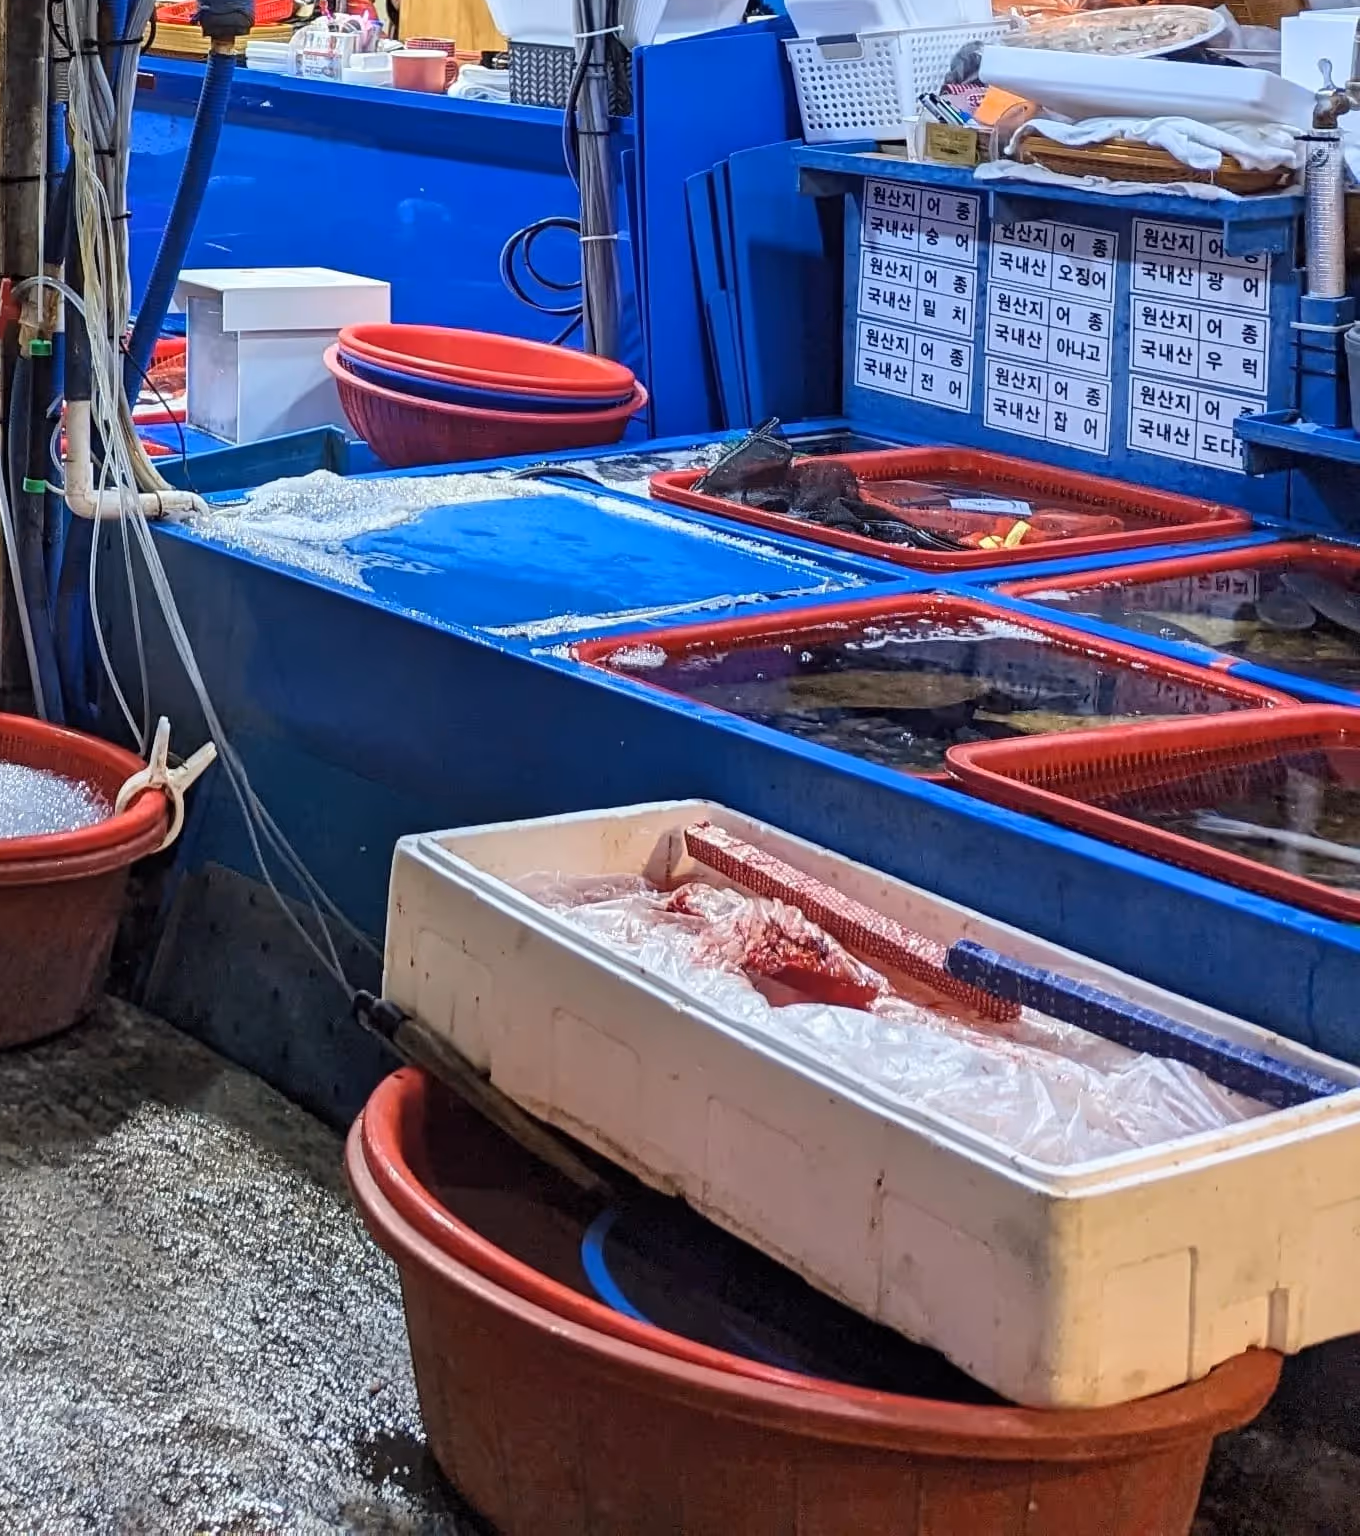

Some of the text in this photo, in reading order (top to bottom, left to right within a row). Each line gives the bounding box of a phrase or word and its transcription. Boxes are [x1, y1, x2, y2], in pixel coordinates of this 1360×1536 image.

[874, 186, 915, 211] 원산지
[871, 216, 914, 240] 국내산
[1001, 222, 1047, 247] 원산지
[1143, 228, 1194, 254] 원산지
[870, 257, 912, 282] 원산지
[999, 252, 1106, 290] 국내산 오징어
[1141, 261, 1194, 286] 국내산
[868, 287, 911, 311] 국내산
[997, 293, 1042, 319] 원산지
[1142, 306, 1192, 333] 원산지
[866, 329, 908, 354] 원산지
[995, 324, 1100, 362] 국내산 아나고
[1140, 339, 1192, 365] 국내산
[864, 358, 907, 383] 국내산
[995, 368, 1040, 394] 원산지
[993, 398, 1040, 424] 국내산
[1140, 385, 1190, 414] 원산지
[1139, 418, 1190, 446] 국내산
